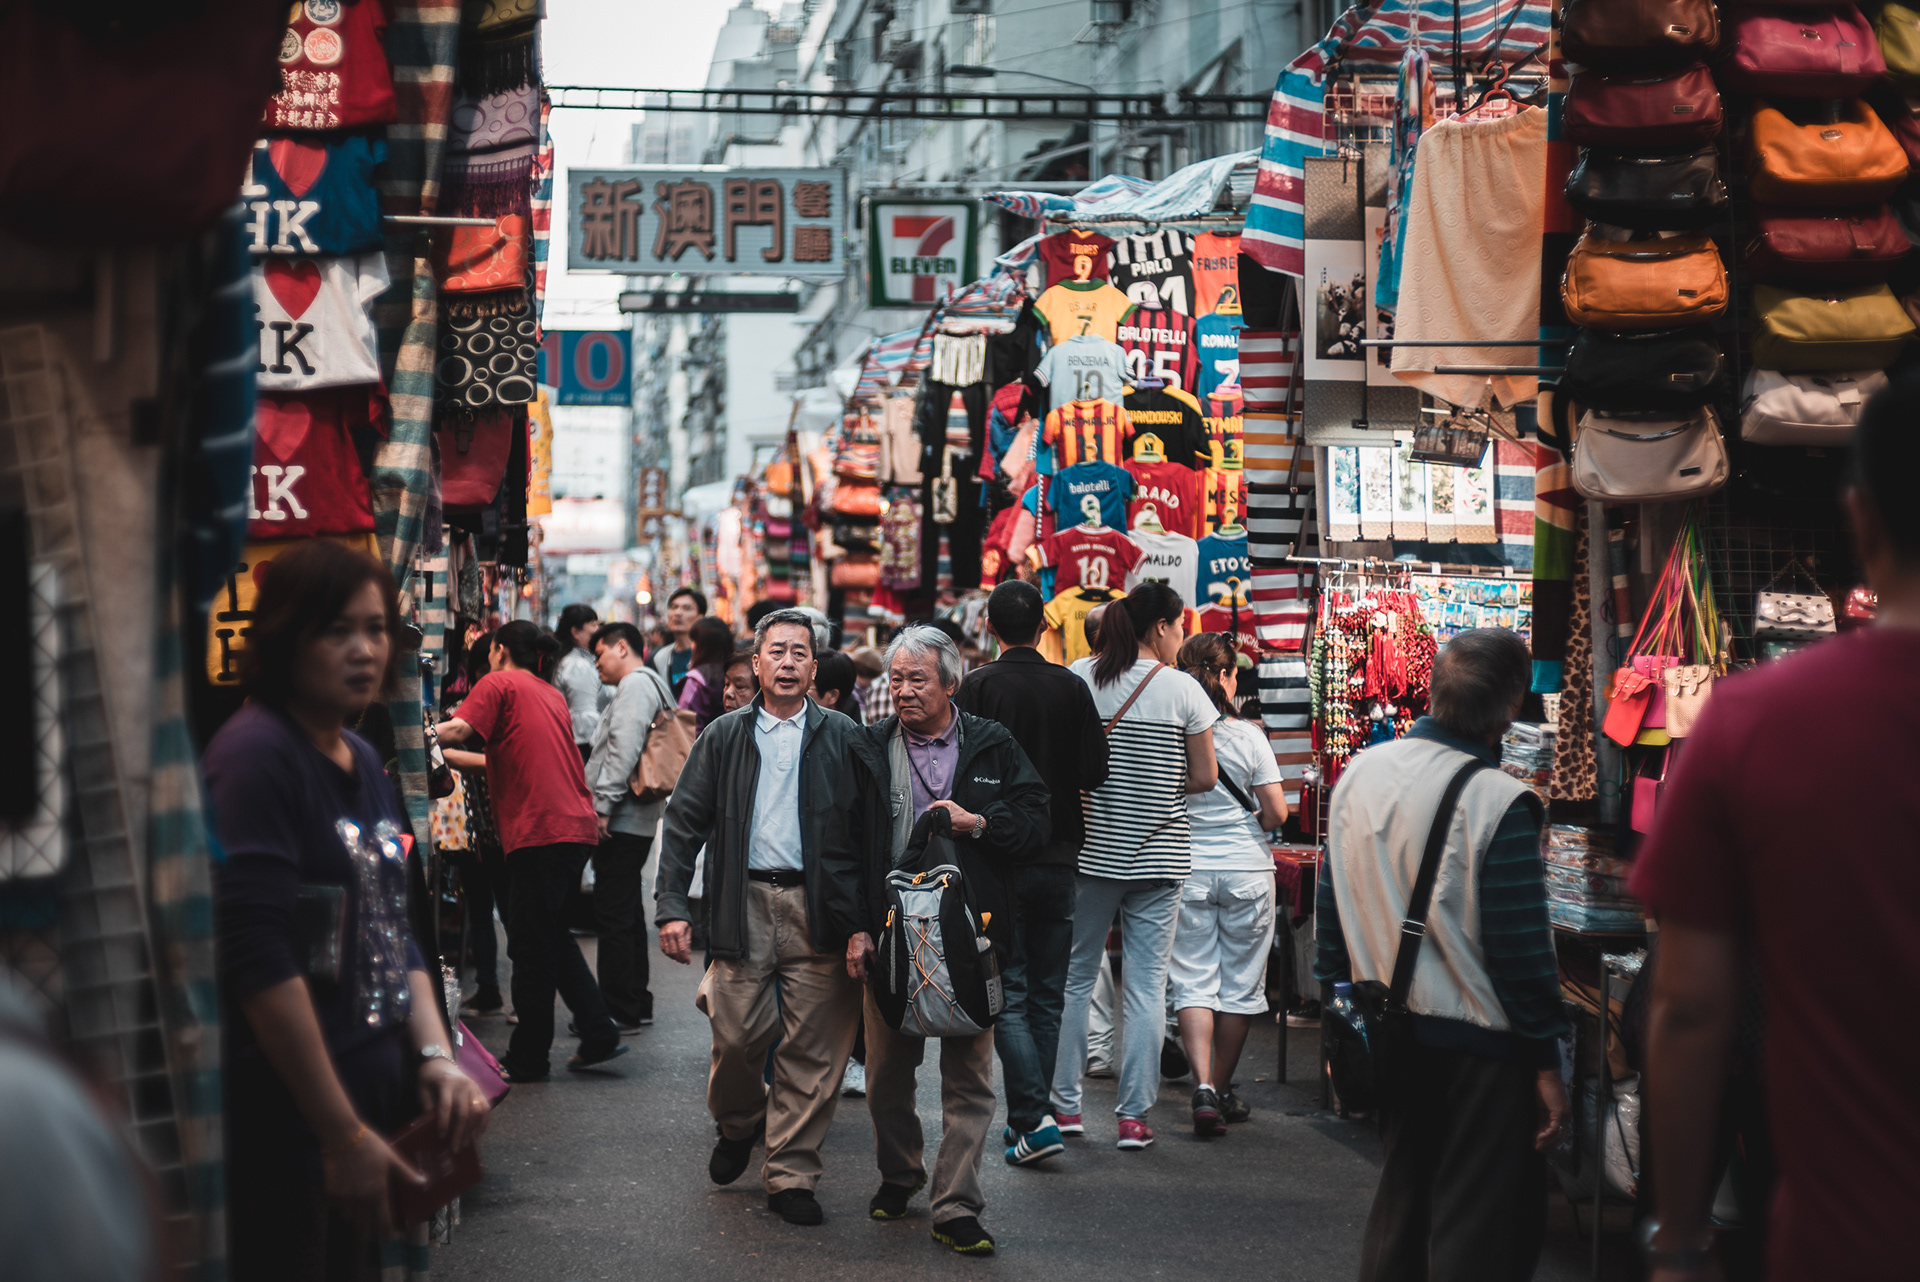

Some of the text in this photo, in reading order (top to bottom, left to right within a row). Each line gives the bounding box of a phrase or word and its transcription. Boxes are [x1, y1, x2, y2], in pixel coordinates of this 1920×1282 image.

[581, 177, 784, 262] 新澳門
[893, 215, 954, 302] 7
[1074, 255, 1093, 281] 9
[1130, 257, 1173, 277] PIRLO
[1069, 302, 1098, 312] OSAR
[1077, 315, 1093, 336] 7
[1117, 326, 1187, 345] BALOTELLI
[1201, 334, 1240, 348] RONAL
[1068, 355, 1110, 366] BENZEMA
[1214, 358, 1240, 387] 7
[1074, 369, 1104, 400] 10
[1064, 416, 1102, 427] NEYMAR
[1076, 433, 1102, 462] 11
[1069, 480, 1110, 494] balotelli
[1137, 485, 1179, 509] RARD
[1077, 555, 1110, 587] 10
